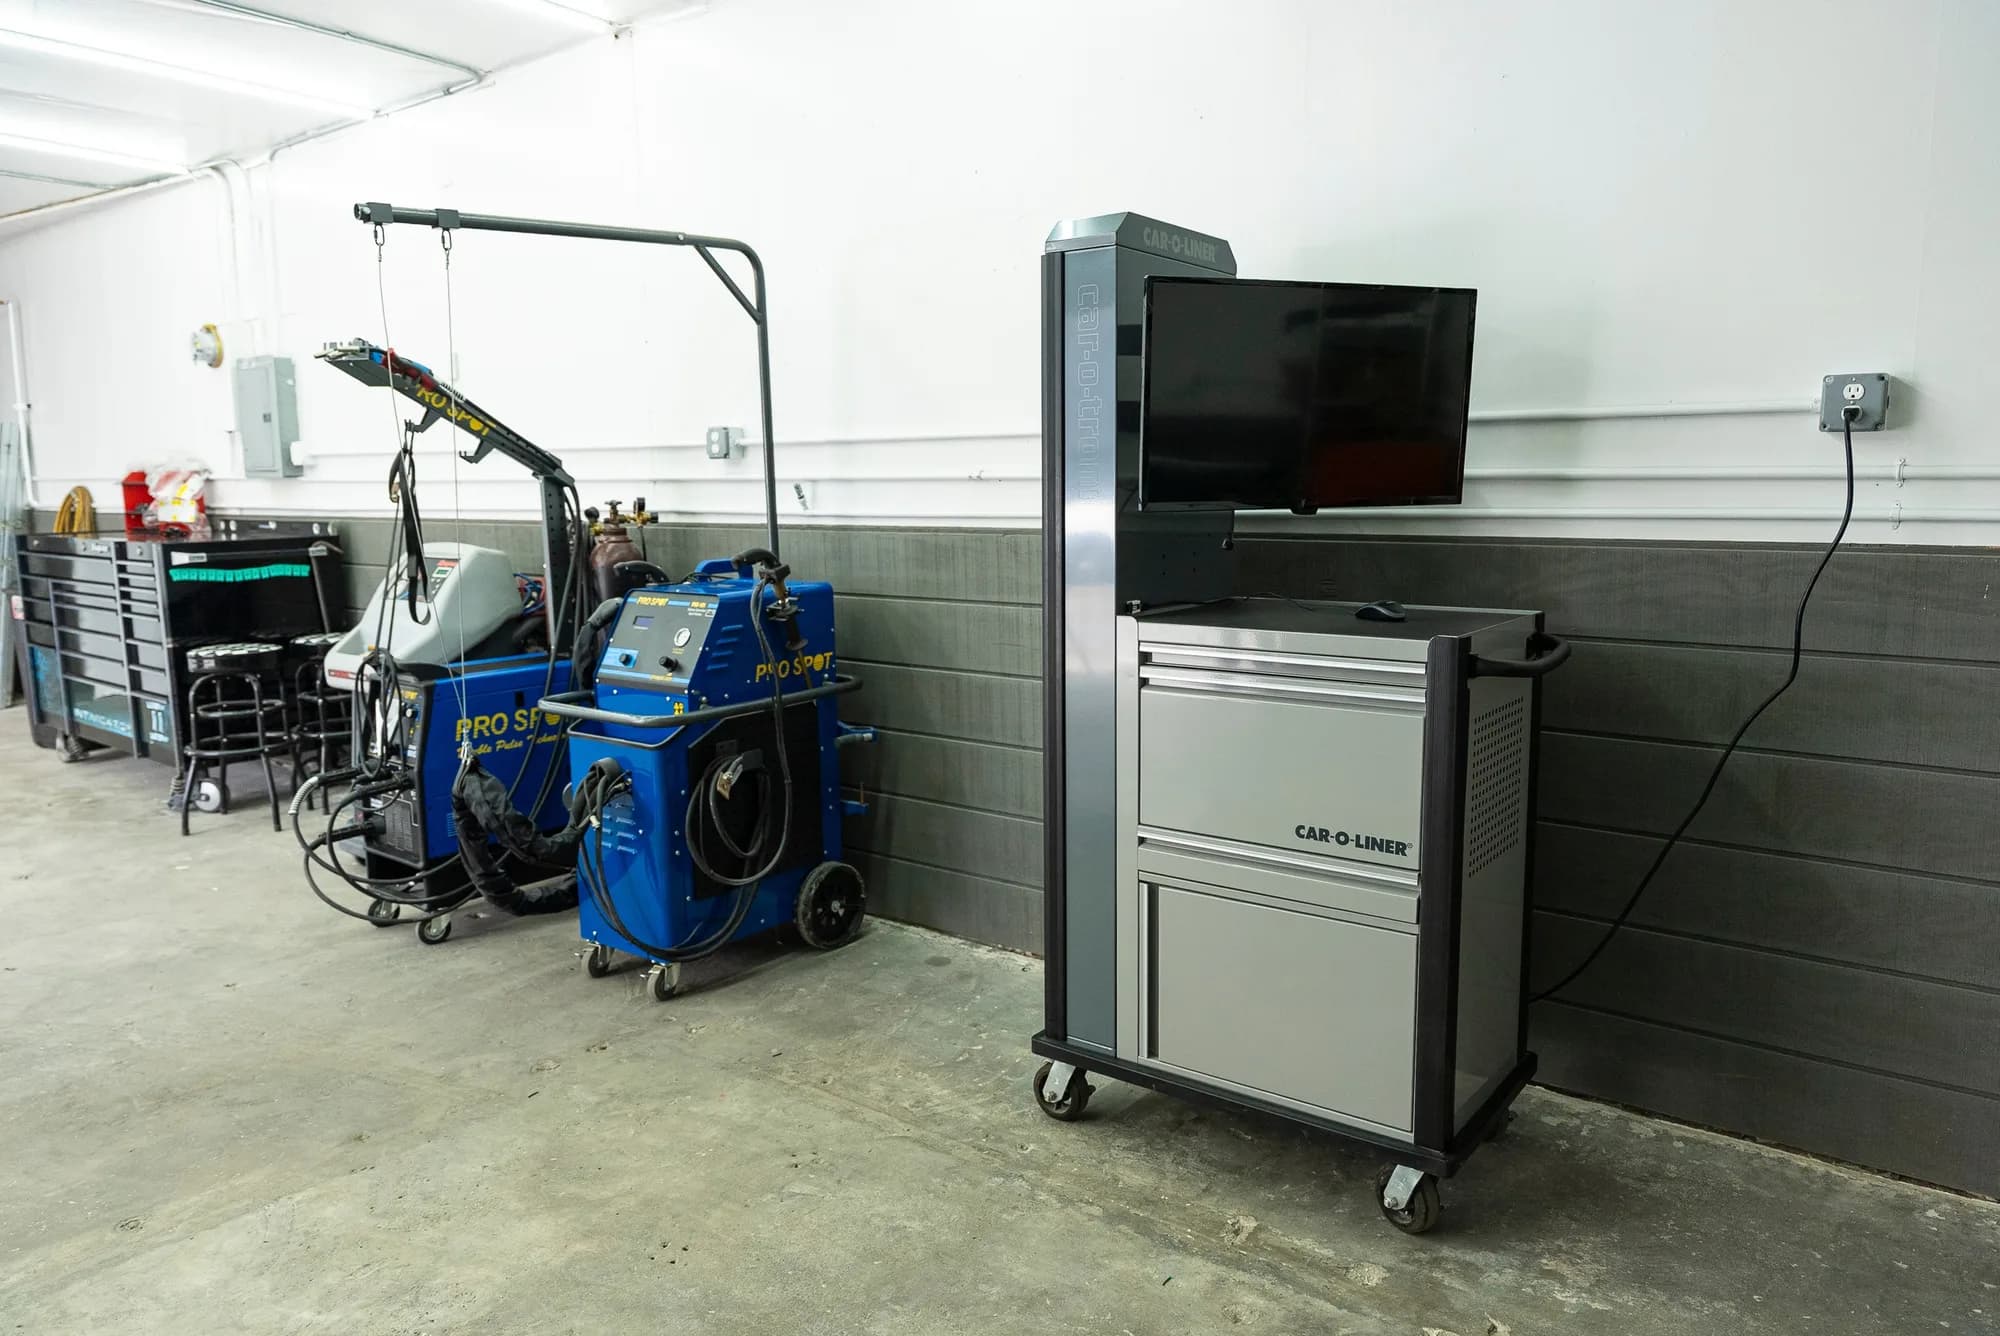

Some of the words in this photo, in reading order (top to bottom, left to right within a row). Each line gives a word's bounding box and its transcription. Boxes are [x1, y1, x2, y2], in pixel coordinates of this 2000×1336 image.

[1143, 226, 1217, 263] CAR-O-LINER
[792, 652, 833, 676] SPOT
[455, 712, 509, 742] PRO
[513, 706, 561, 732] SPO
[1294, 824, 1409, 857] CAR-O-LINER
